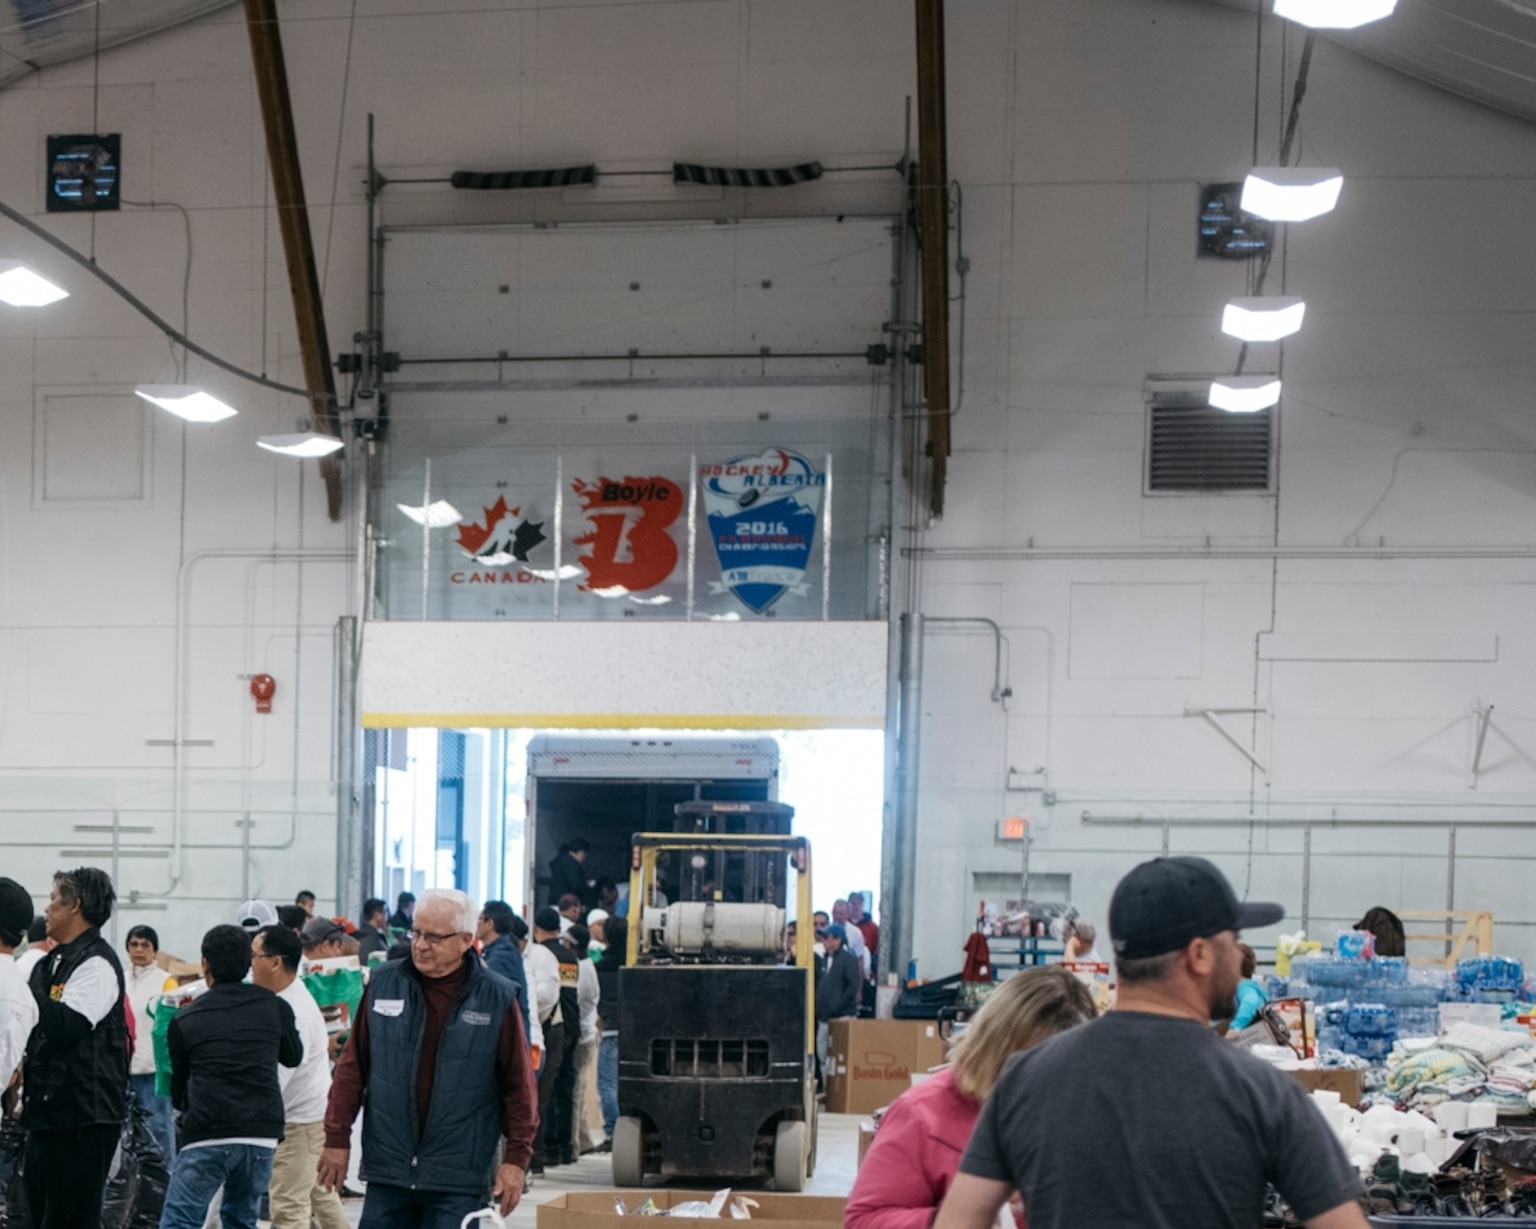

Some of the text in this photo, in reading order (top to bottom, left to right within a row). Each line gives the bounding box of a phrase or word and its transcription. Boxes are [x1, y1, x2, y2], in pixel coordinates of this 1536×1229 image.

[699, 464, 783, 476] HOCKEY
[601, 483, 670, 504] Boyle
[735, 521, 789, 535] 2016
[450, 571, 546, 584] CANADA
[853, 1065, 909, 1080] Basin Gold
